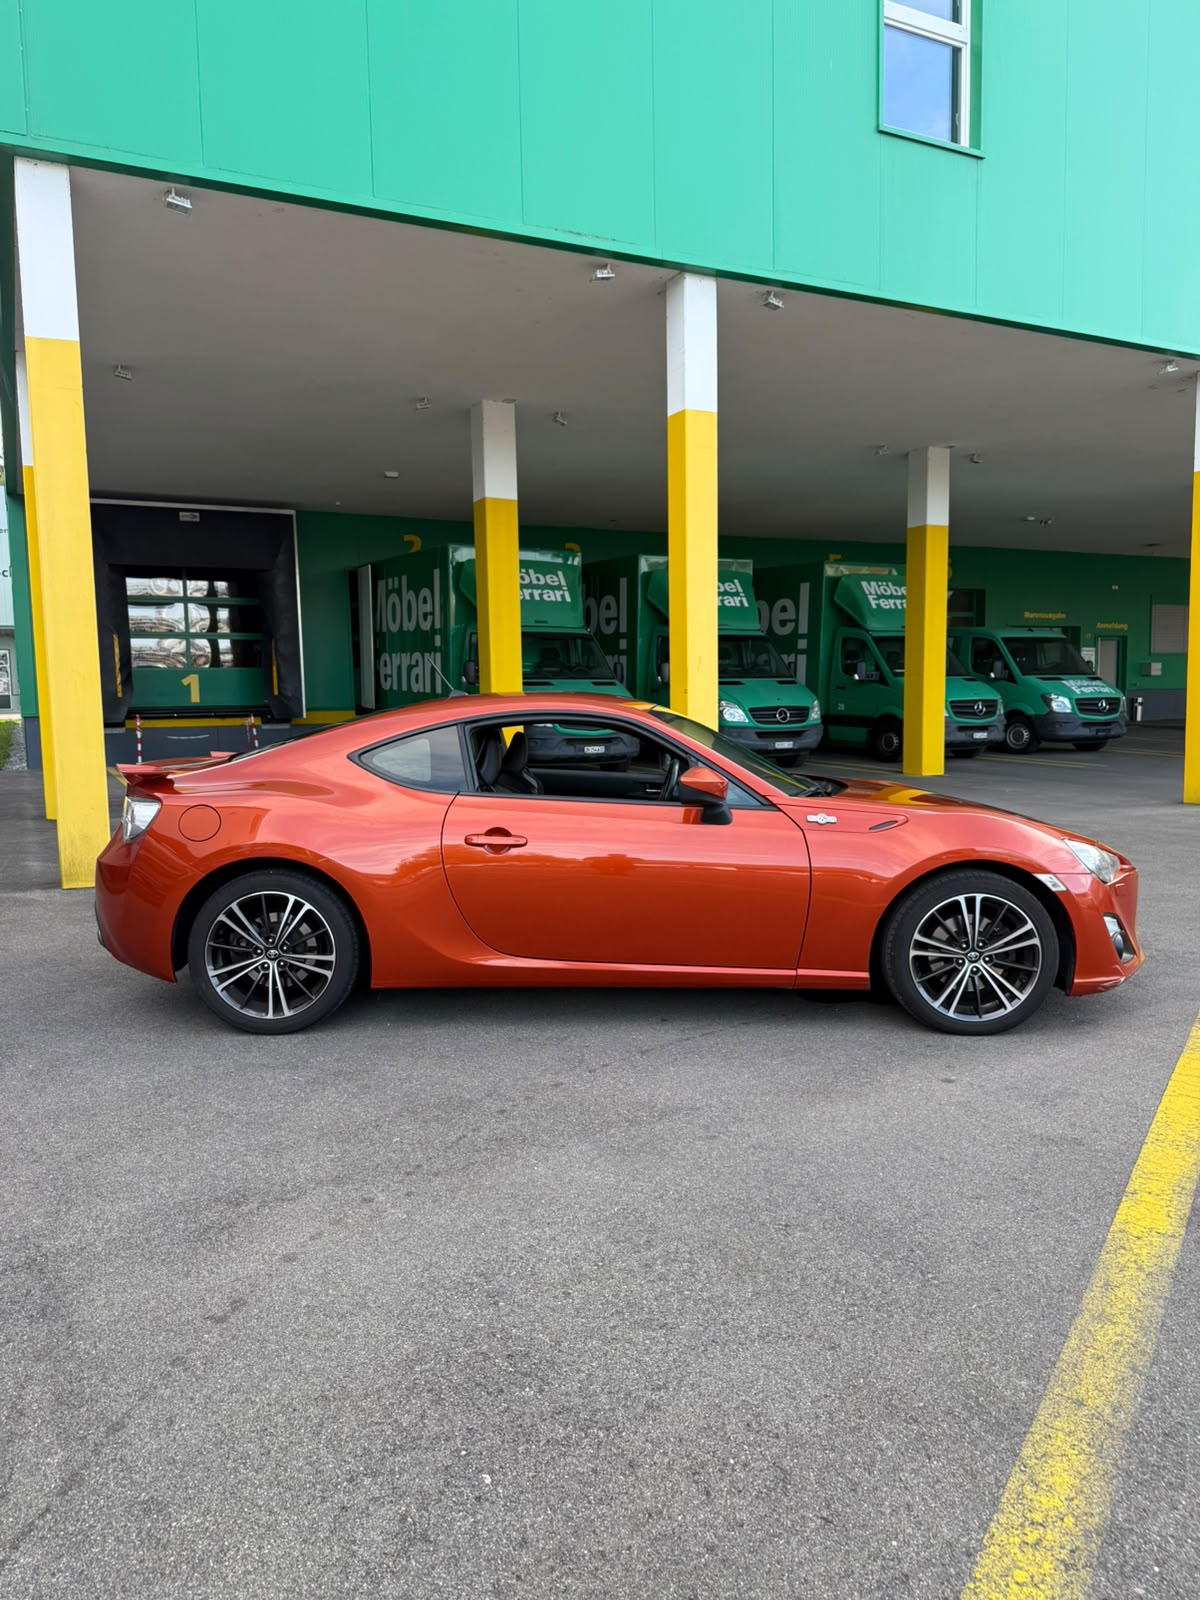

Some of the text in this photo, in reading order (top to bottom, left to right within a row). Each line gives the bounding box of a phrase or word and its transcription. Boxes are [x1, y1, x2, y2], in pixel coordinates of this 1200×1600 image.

[519, 569, 567, 586] öbel
[378, 634, 442, 694] errari
[181, 674, 200, 703] 1
